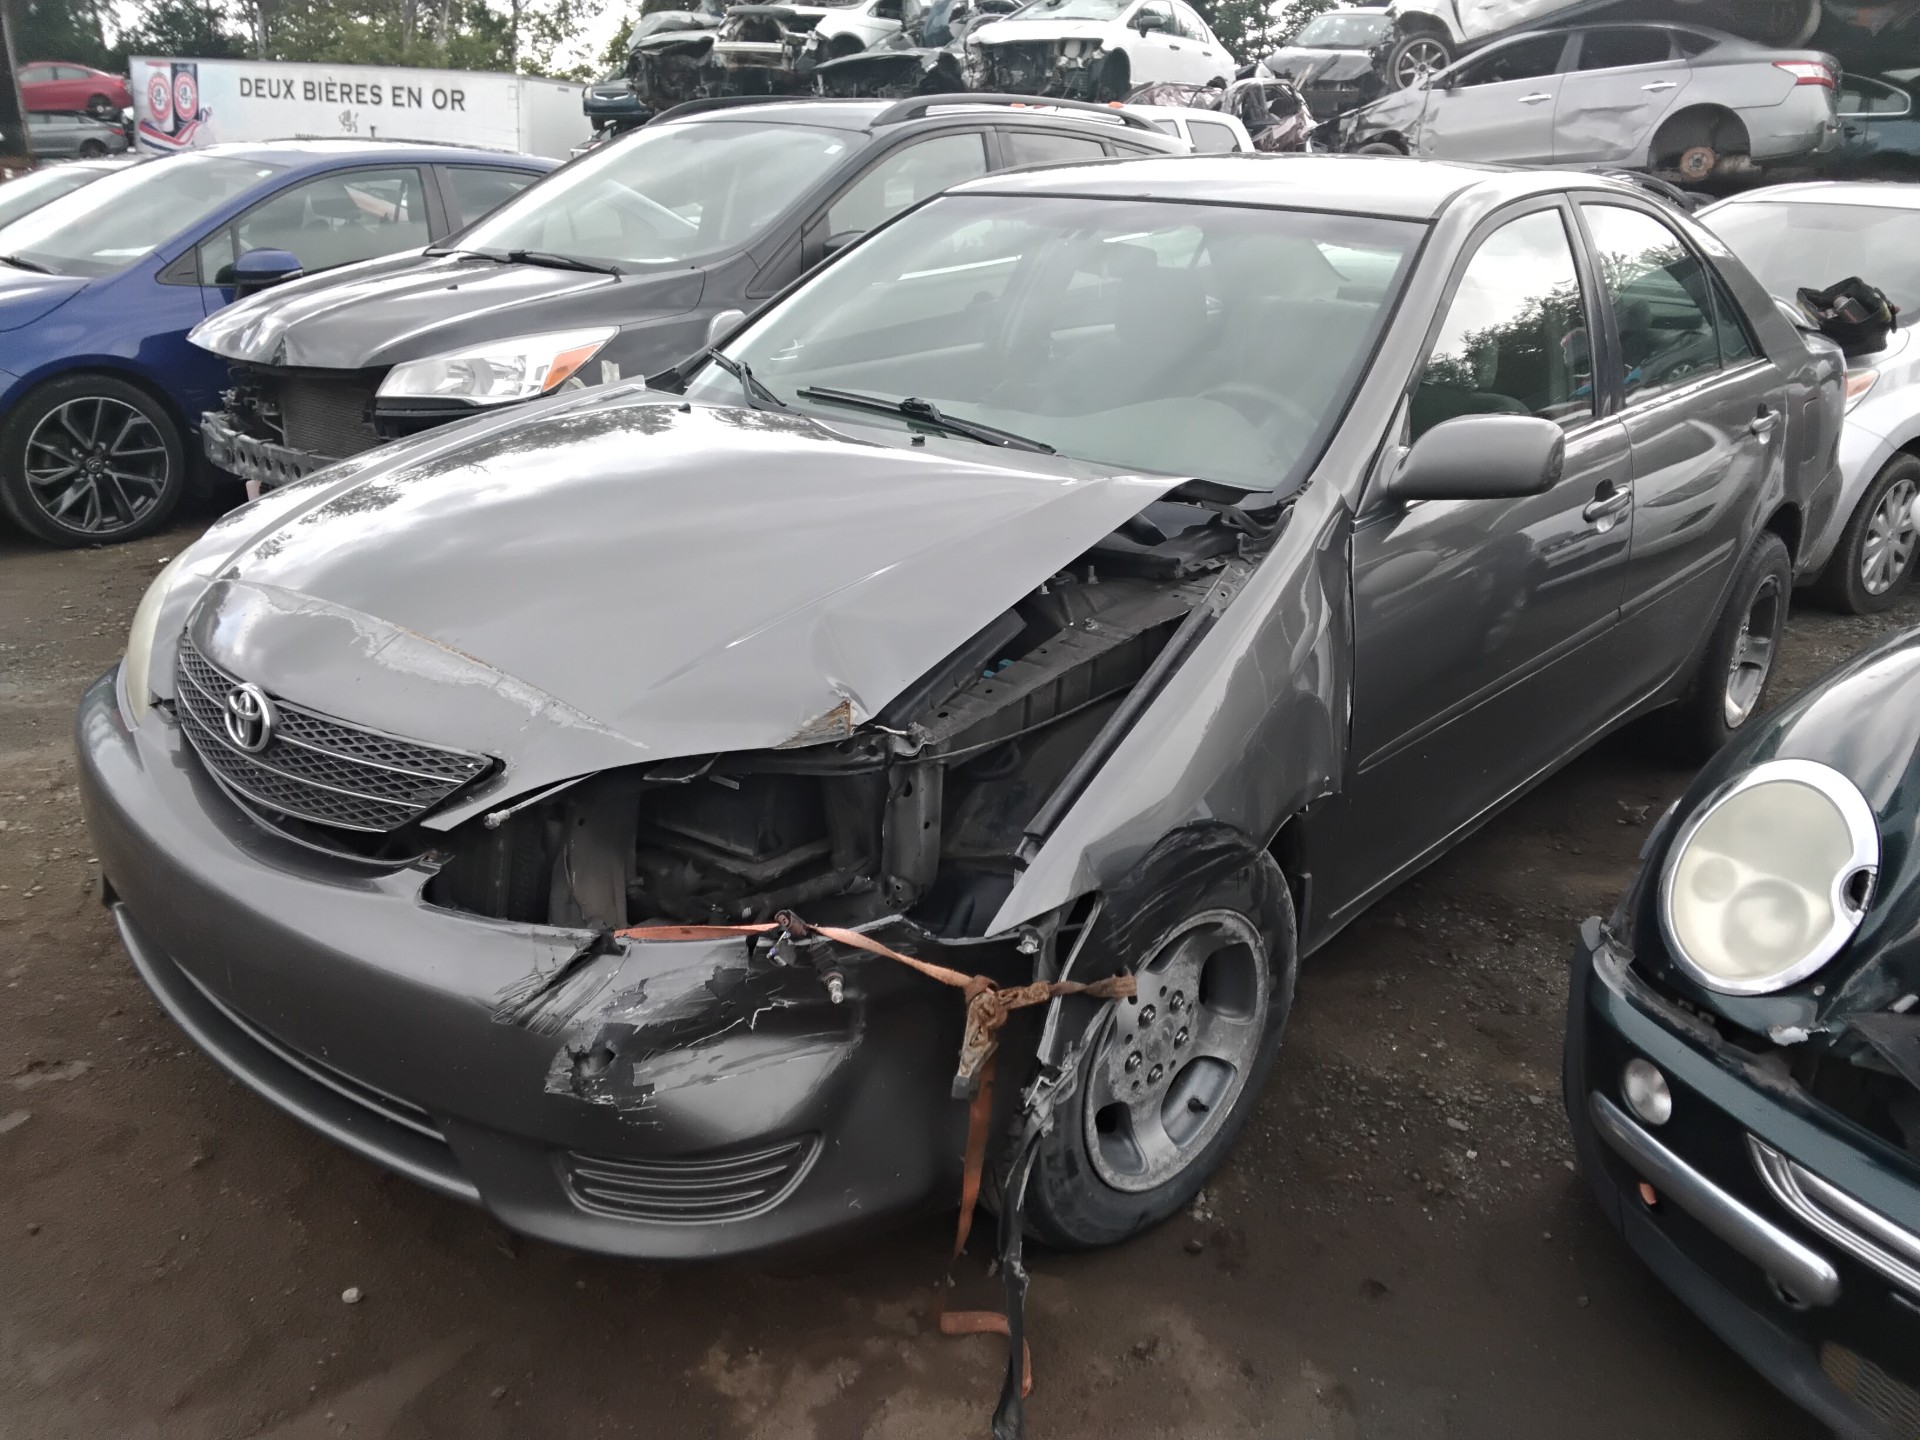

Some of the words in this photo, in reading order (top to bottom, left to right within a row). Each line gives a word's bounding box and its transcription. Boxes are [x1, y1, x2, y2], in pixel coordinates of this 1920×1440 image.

[240, 77, 296, 100] DEUX
[303, 76, 383, 105] BIÈRES
[391, 86, 422, 109] EN
[432, 88, 466, 112] OR
